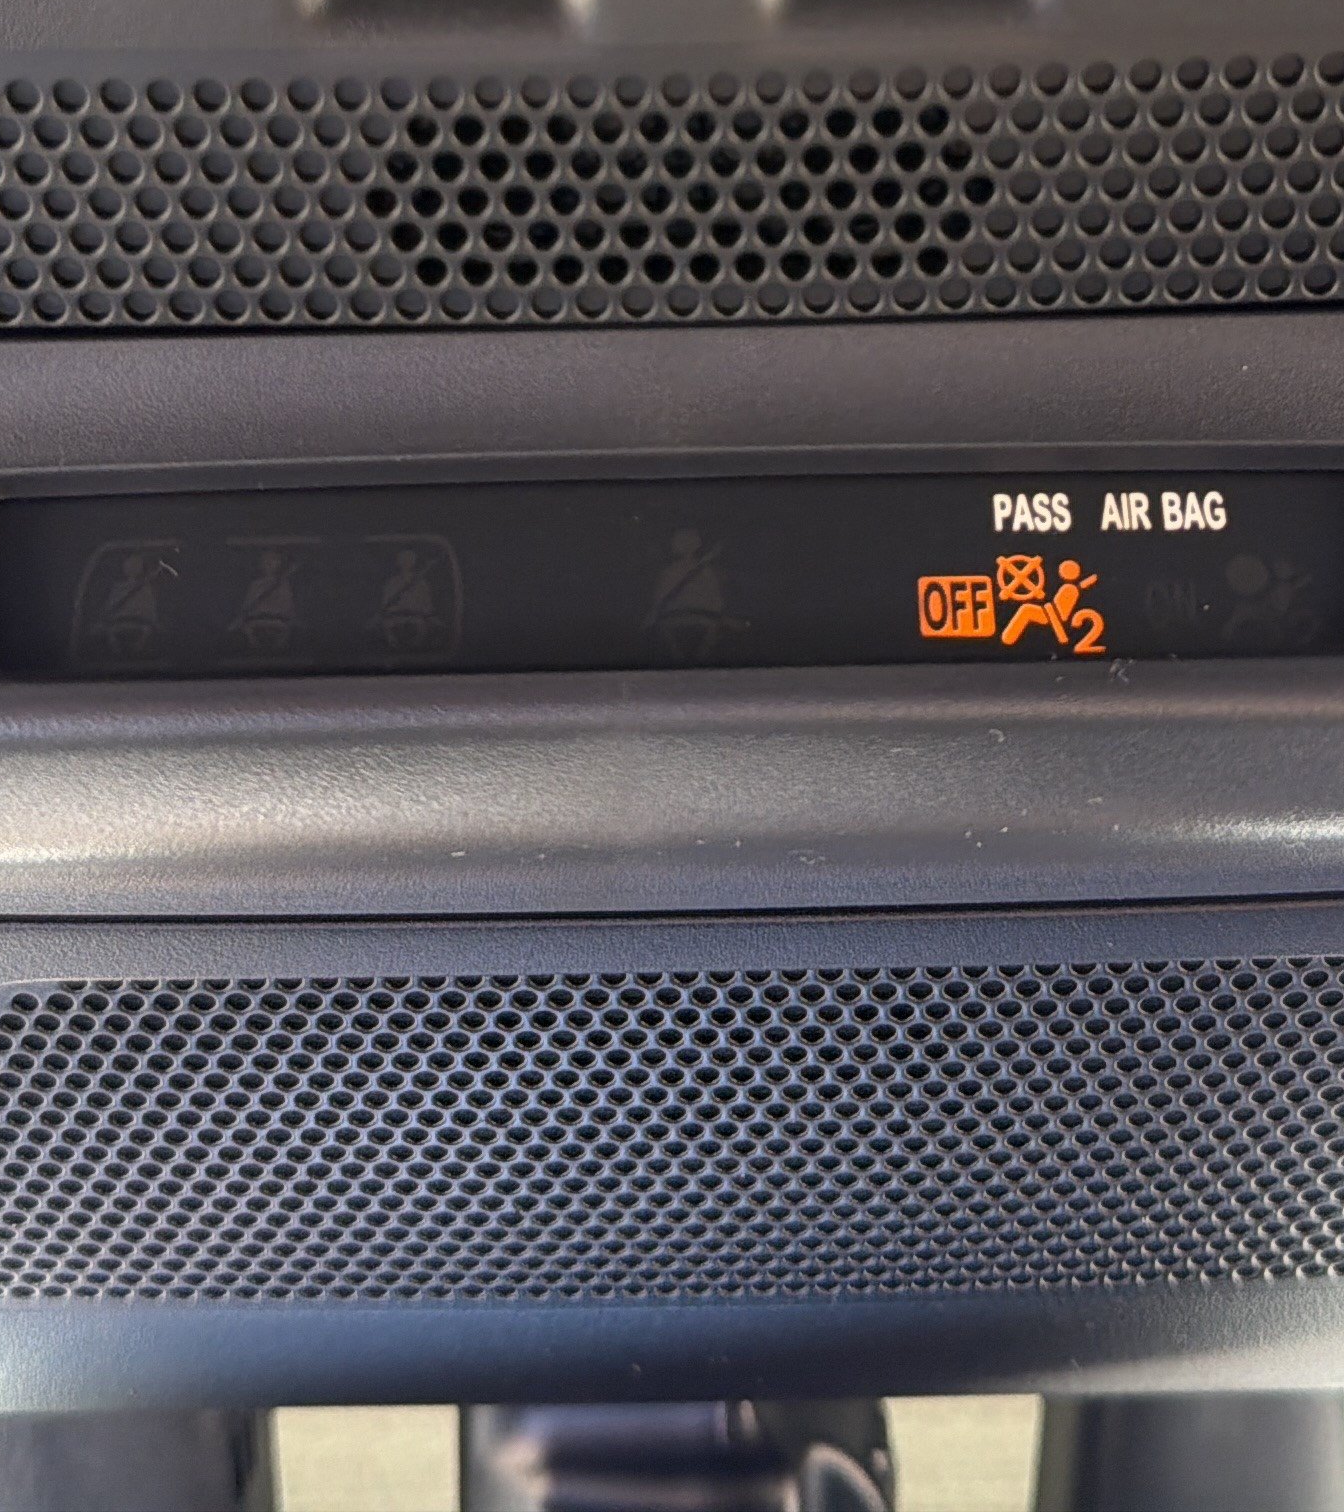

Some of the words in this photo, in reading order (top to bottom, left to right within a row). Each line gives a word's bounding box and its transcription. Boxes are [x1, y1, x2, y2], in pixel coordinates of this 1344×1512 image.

[993, 492, 1072, 532] PASS
[1100, 492, 1153, 531] AIR
[1161, 491, 1227, 530] BAG
[923, 583, 988, 632] OFF
